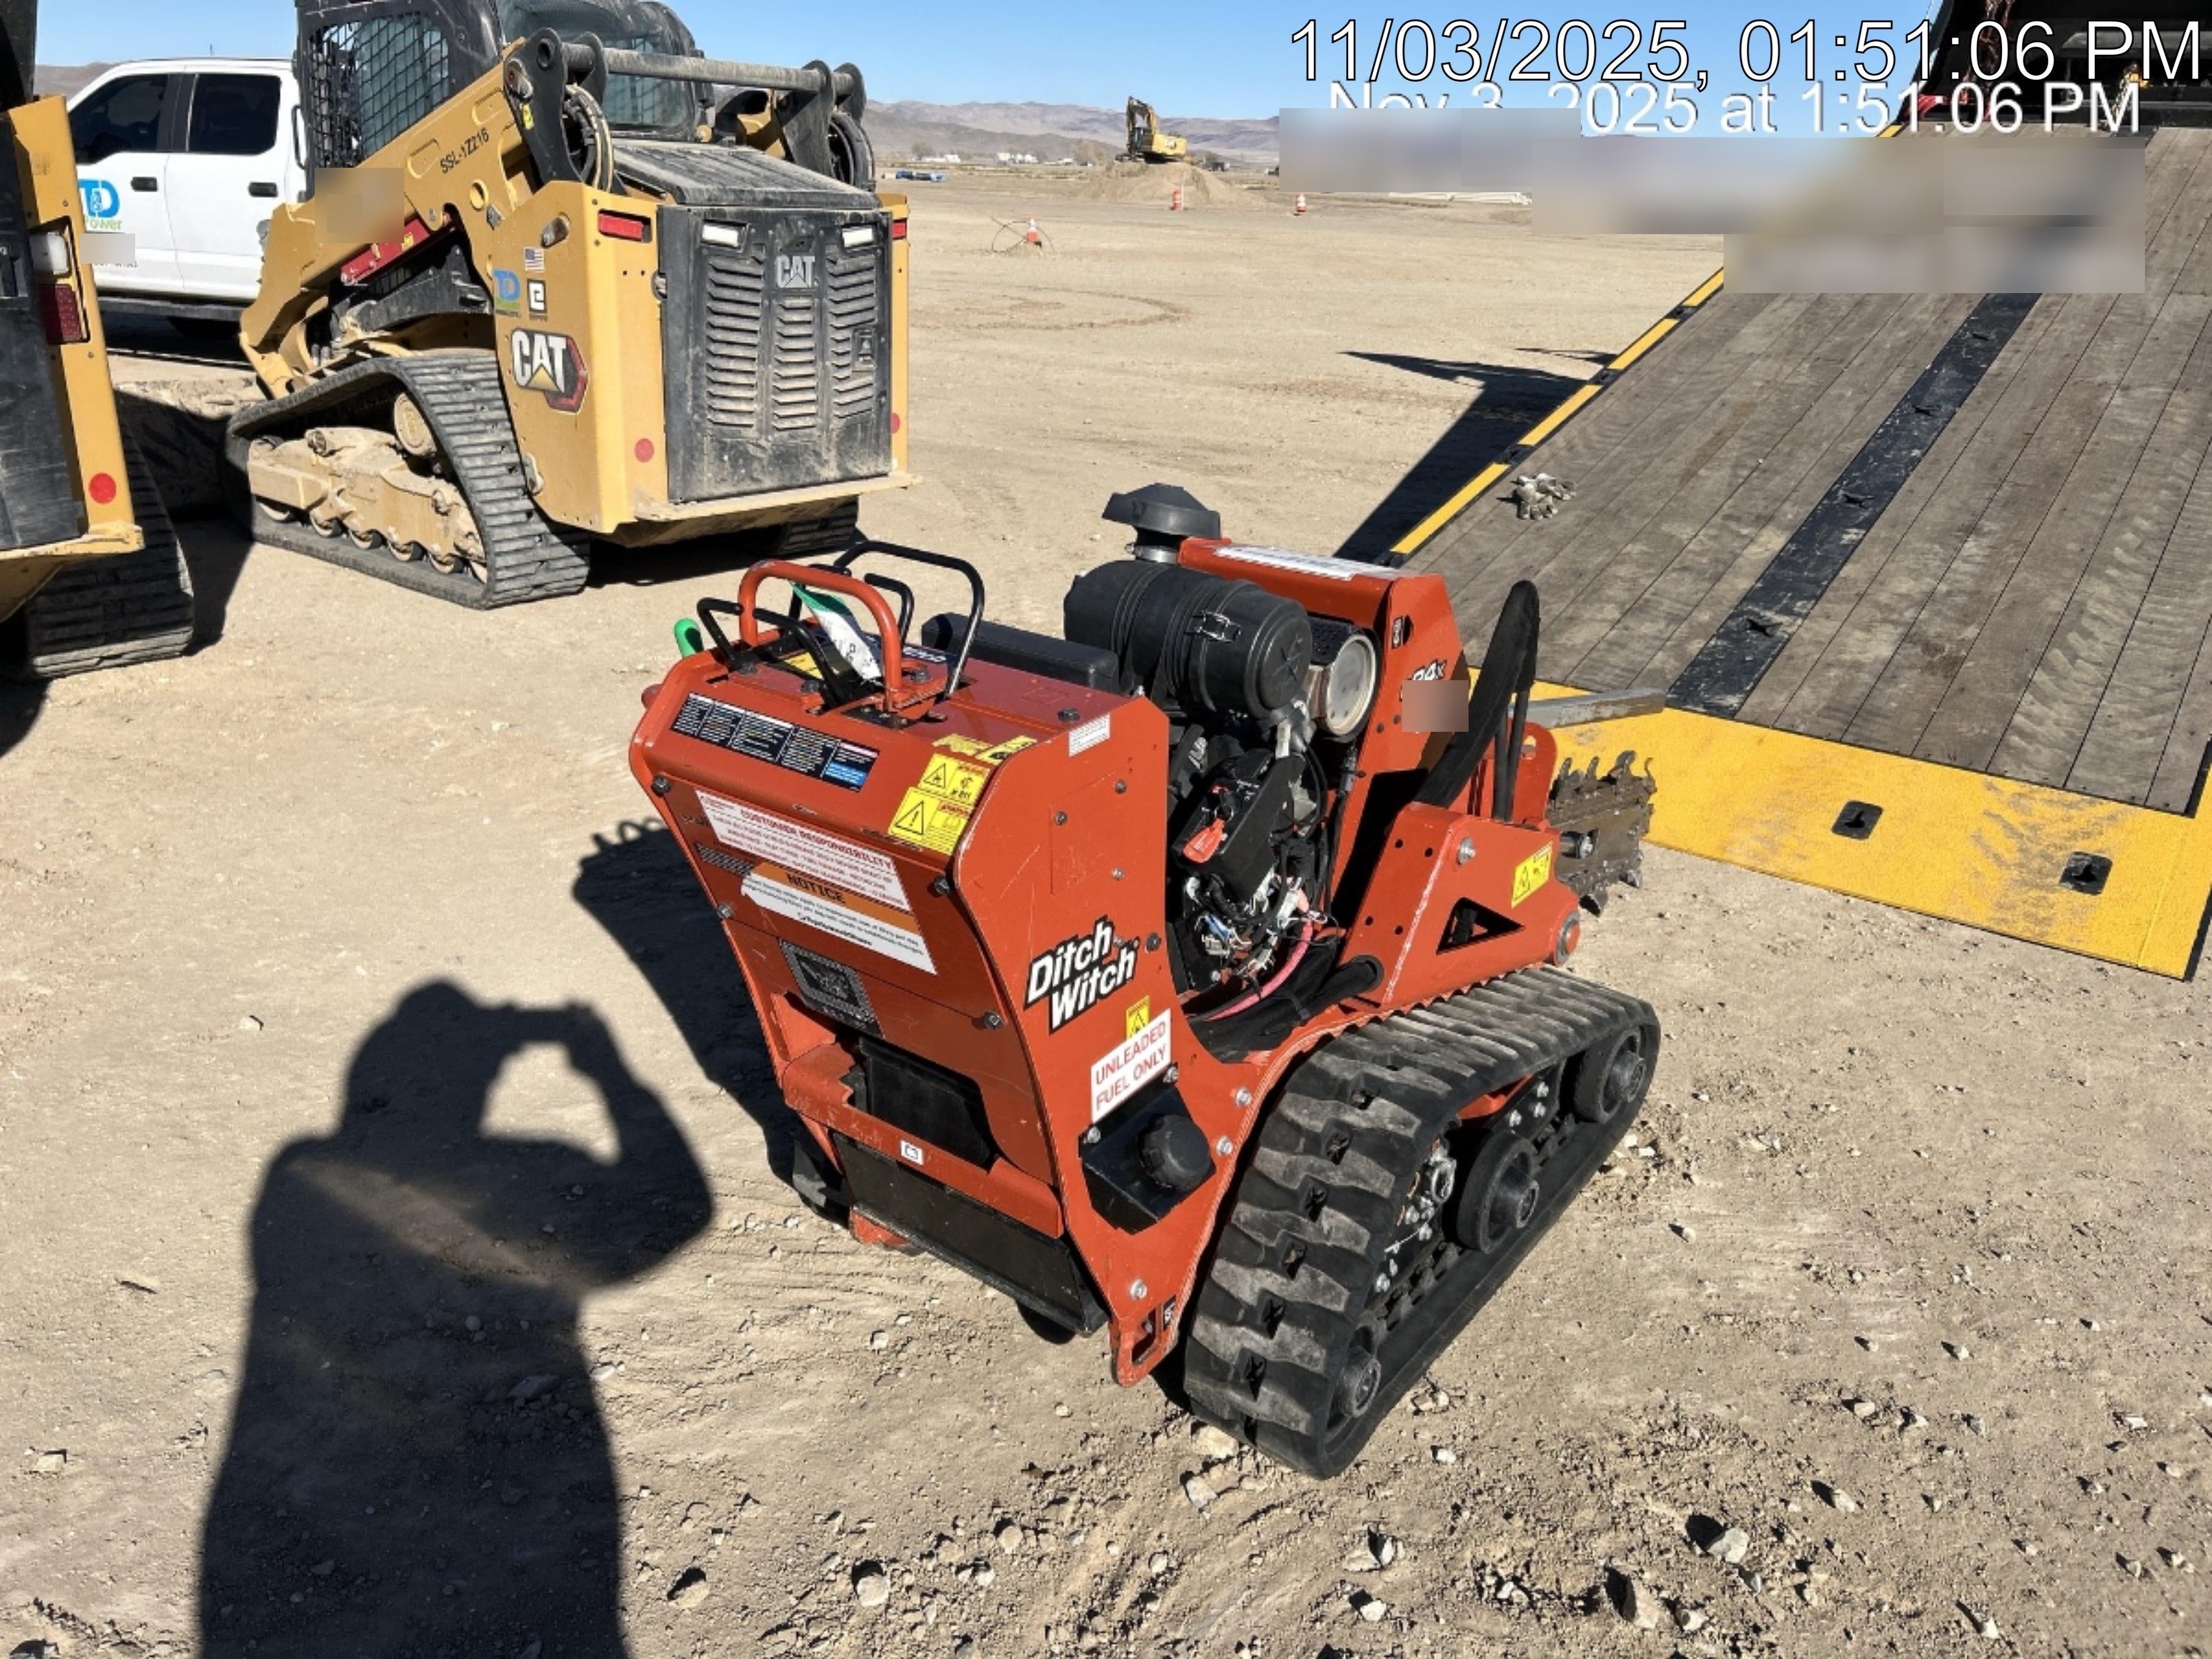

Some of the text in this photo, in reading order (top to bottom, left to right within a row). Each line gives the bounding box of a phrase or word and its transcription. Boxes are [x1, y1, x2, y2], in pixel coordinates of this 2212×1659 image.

[777, 255, 815, 288] CAT
[512, 329, 567, 393] CAT
[786, 873, 846, 905] NOTICE
[1026, 919, 1113, 1005] Ditch
[1051, 947, 1137, 1030] Witch
[1096, 1020, 1166, 1085] UNLEADED
[1096, 1044, 1167, 1112] FUEL ONLY
